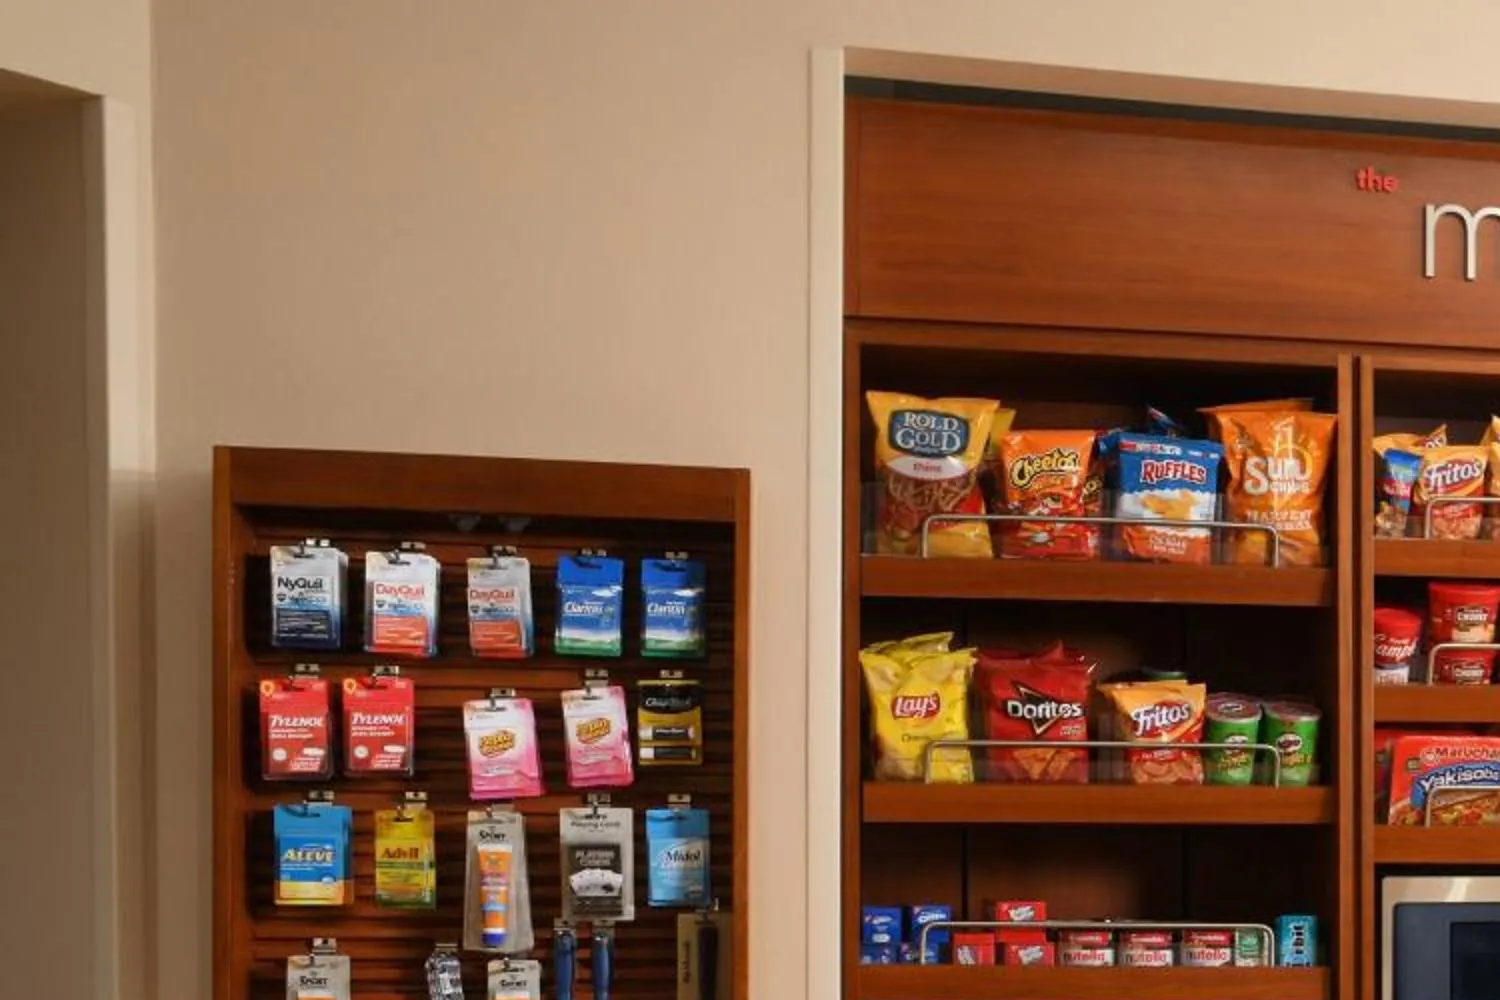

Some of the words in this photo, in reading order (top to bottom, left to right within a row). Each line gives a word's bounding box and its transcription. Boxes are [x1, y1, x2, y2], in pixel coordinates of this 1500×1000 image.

[1355, 166, 1399, 192] the
[903, 412, 959, 430] ROLD
[895, 428, 961, 454] GOLD
[1011, 448, 1080, 489] Cheetos
[1141, 460, 1207, 485] RUFFLES
[1427, 458, 1483, 490] Fritos
[277, 577, 323, 590] NyQuil
[375, 583, 425, 597] DayQuil
[470, 588, 515, 602] DayQuil
[647, 601, 685, 616] Claritin
[895, 693, 938, 718] Lay's
[1007, 699, 1084, 719] Doritos
[270, 715, 324, 727] TYLENOL
[352, 712, 404, 725] TYLENOL
[1132, 703, 1190, 736] Fritos
[1420, 770, 1500, 790] Yakisoba
[283, 849, 335, 863] ALEVE
[382, 848, 419, 859] Advil
[666, 850, 701, 863] Midol
